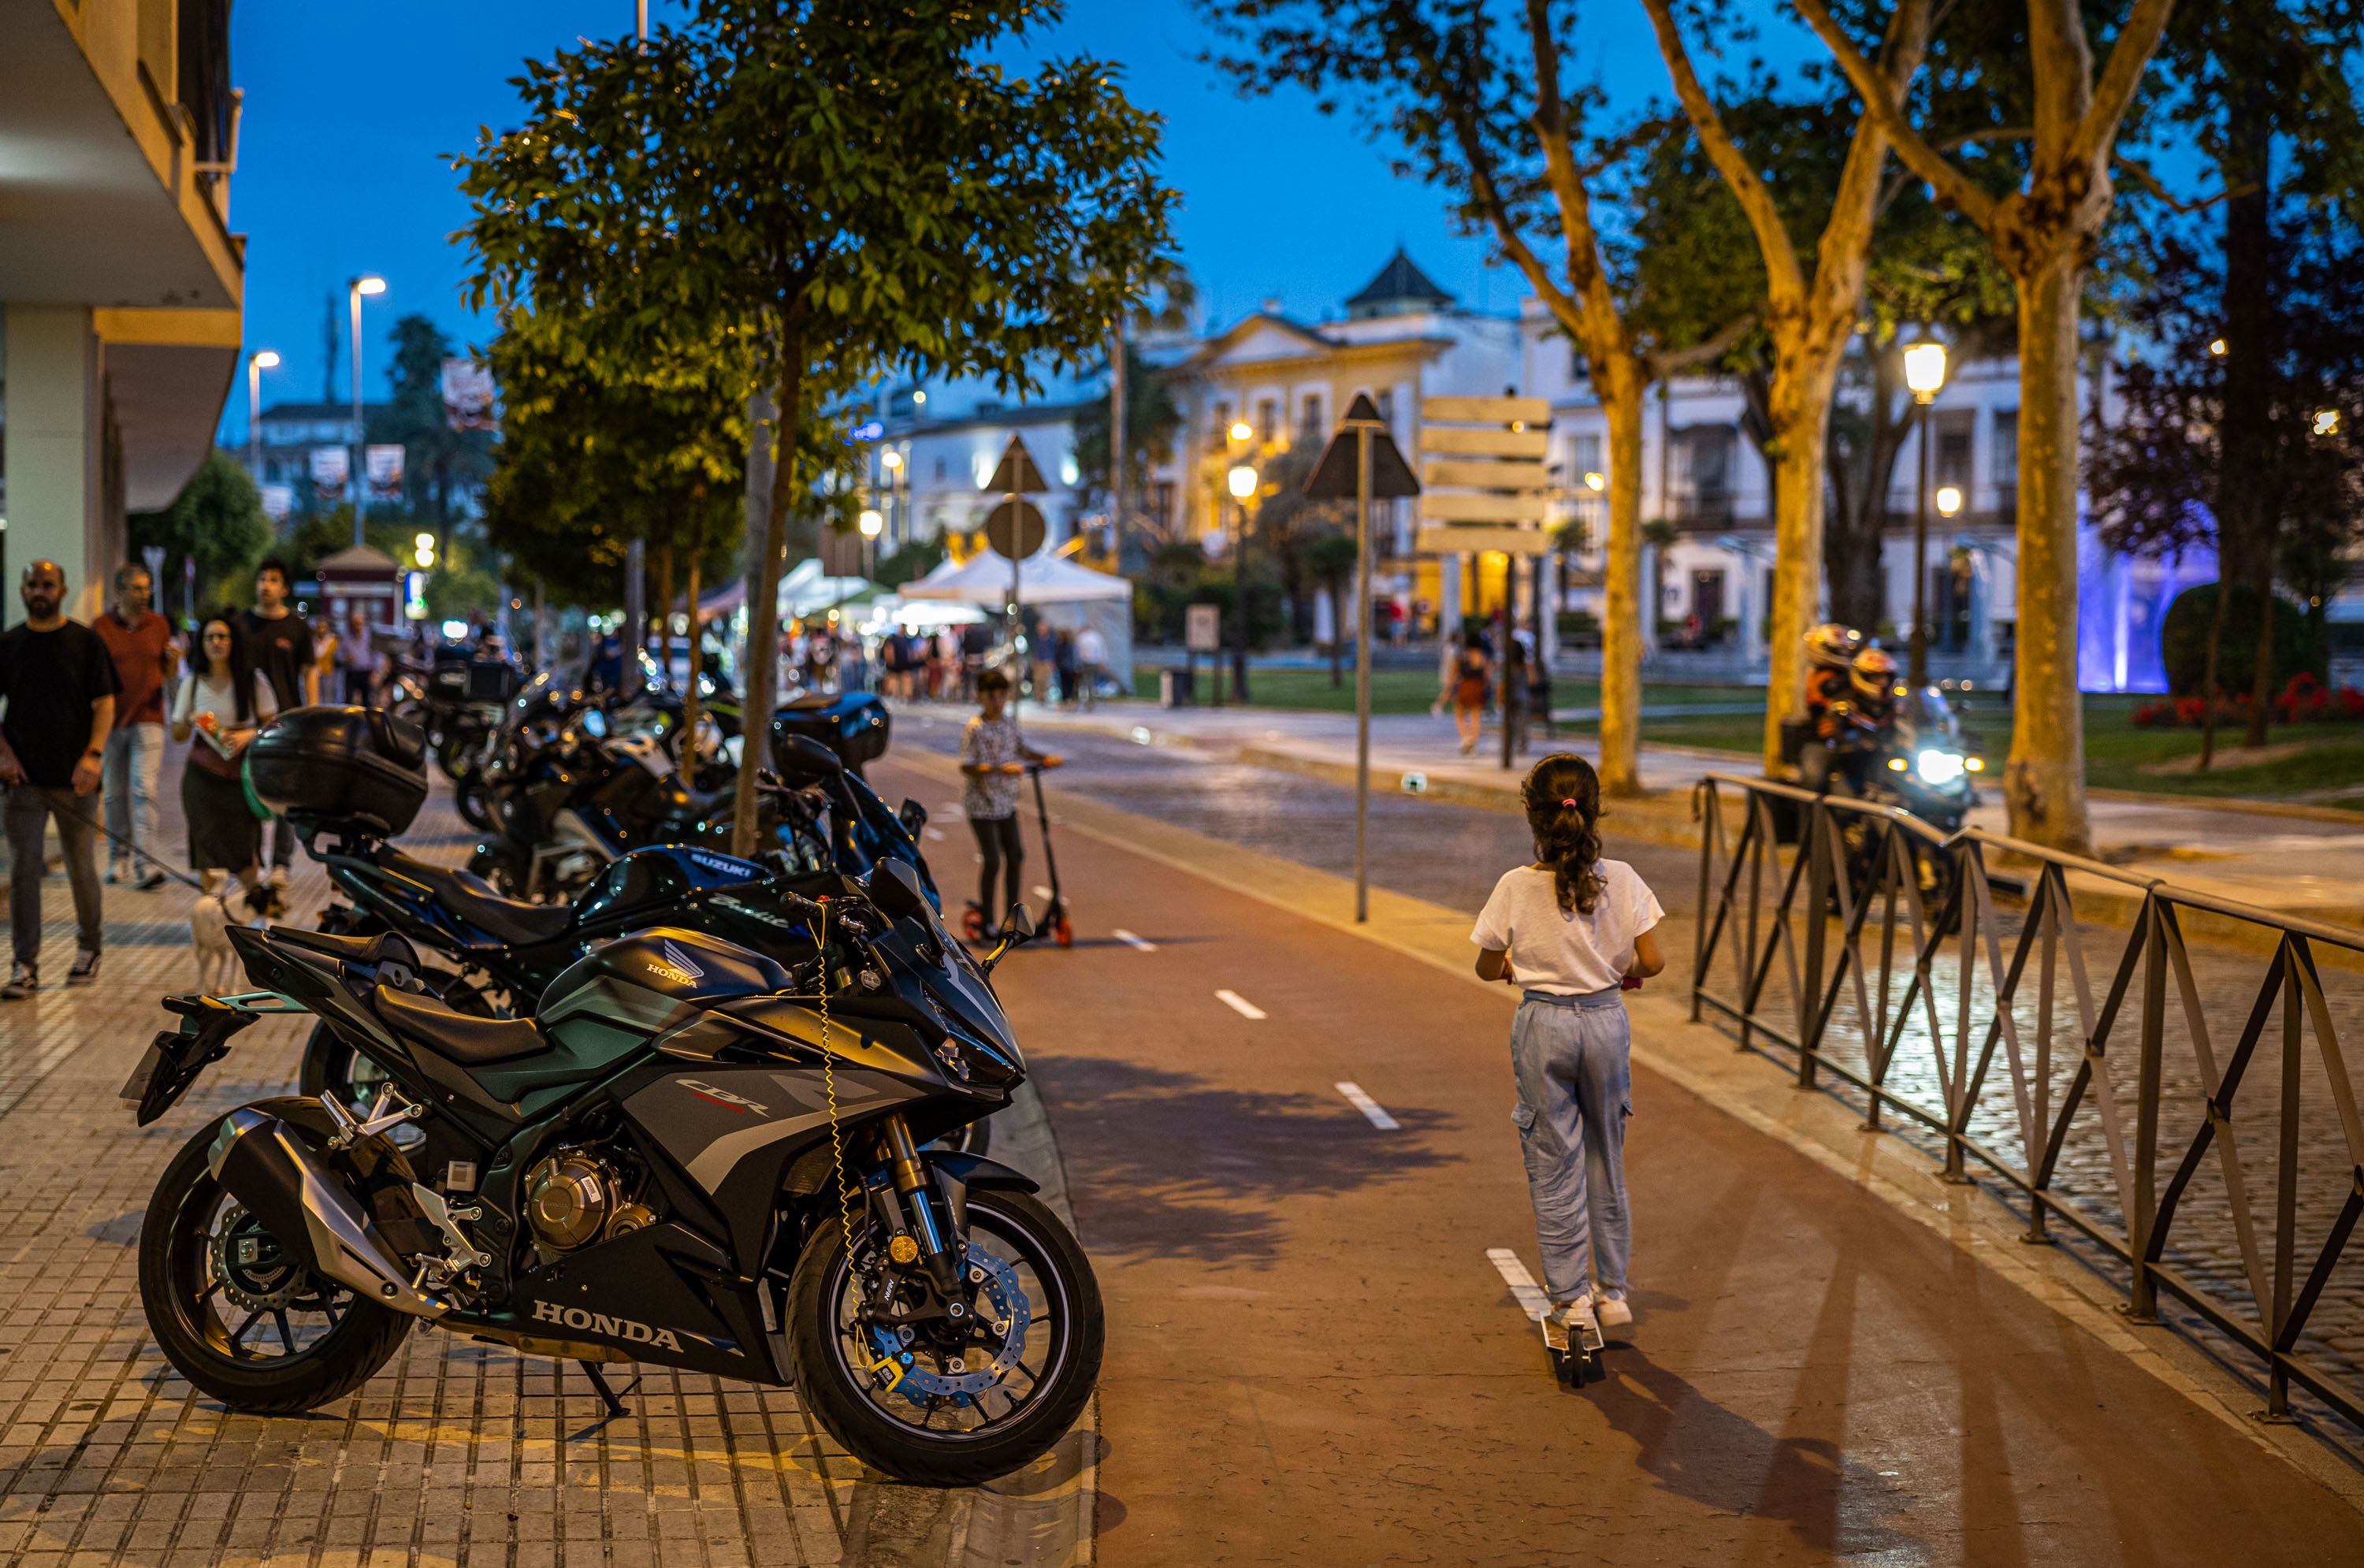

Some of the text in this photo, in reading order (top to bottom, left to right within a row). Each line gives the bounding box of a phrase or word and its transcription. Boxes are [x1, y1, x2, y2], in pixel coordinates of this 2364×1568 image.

[691, 853, 752, 877] SUZUKI
[646, 963, 698, 989] HONDA
[675, 1079, 771, 1118] CBR
[532, 1299, 684, 1353] HONDA
